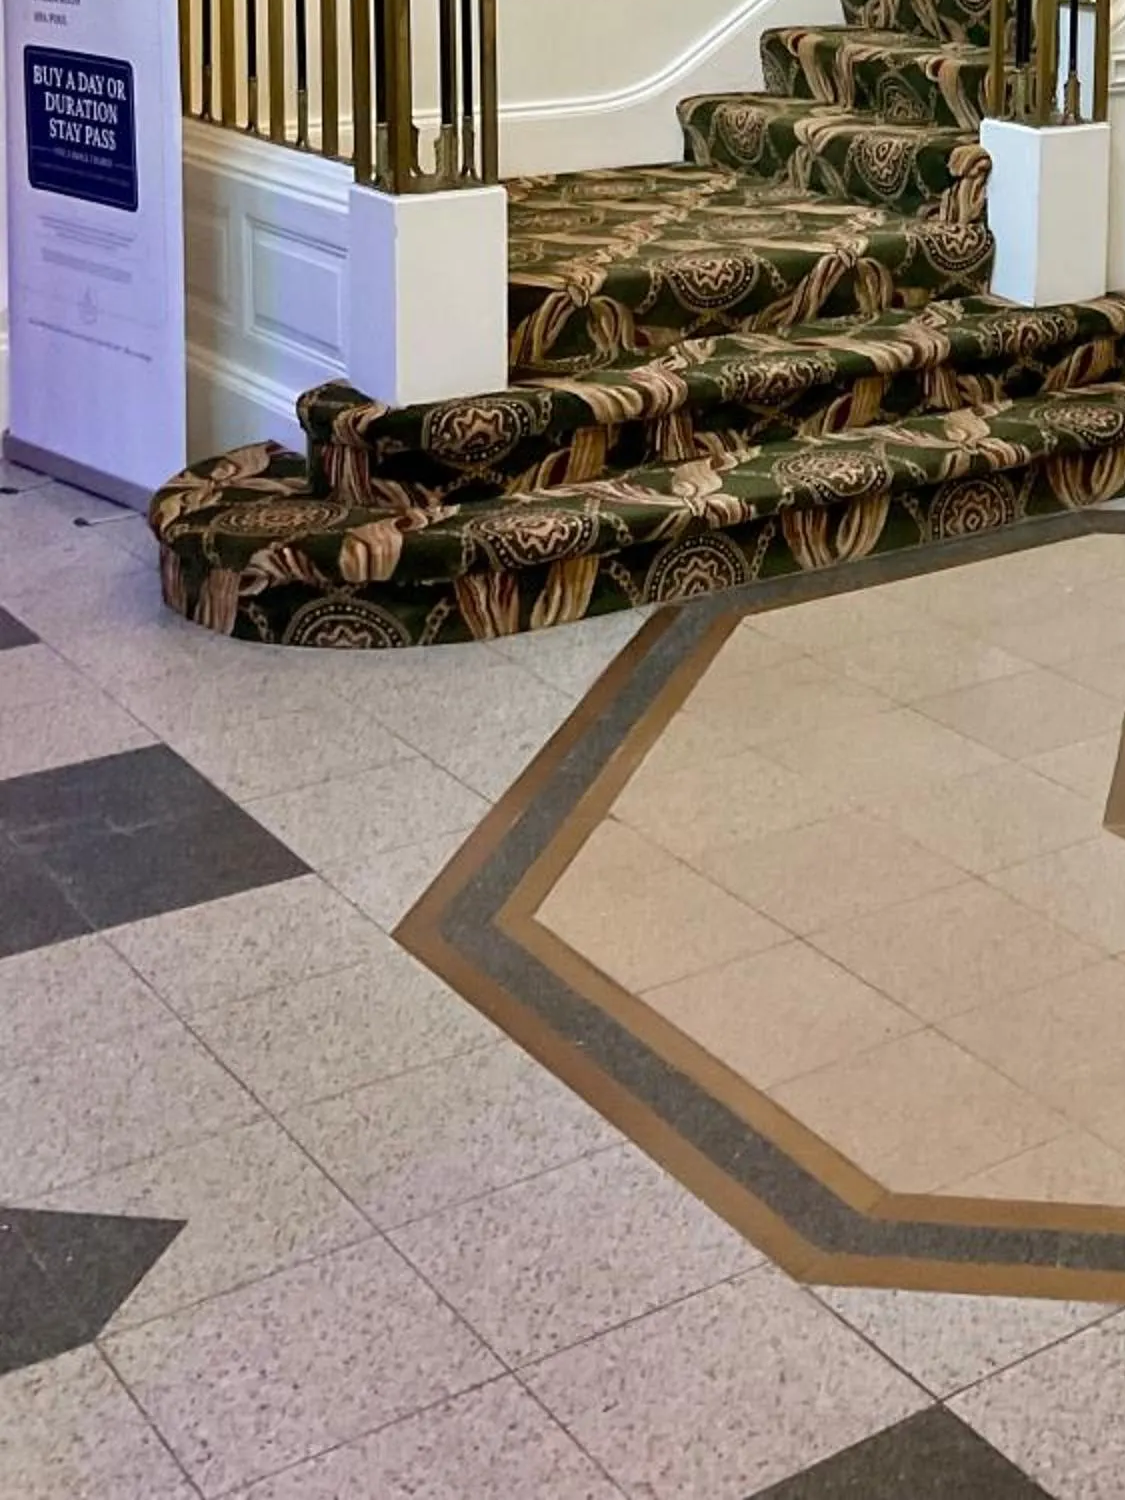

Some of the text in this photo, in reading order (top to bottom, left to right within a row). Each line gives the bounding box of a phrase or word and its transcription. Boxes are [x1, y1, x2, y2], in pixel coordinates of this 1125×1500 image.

[33, 64, 127, 101] BUY A DAY OR
[44, 91, 119, 125] DURATION
[49, 117, 117, 151] STAY PASS
